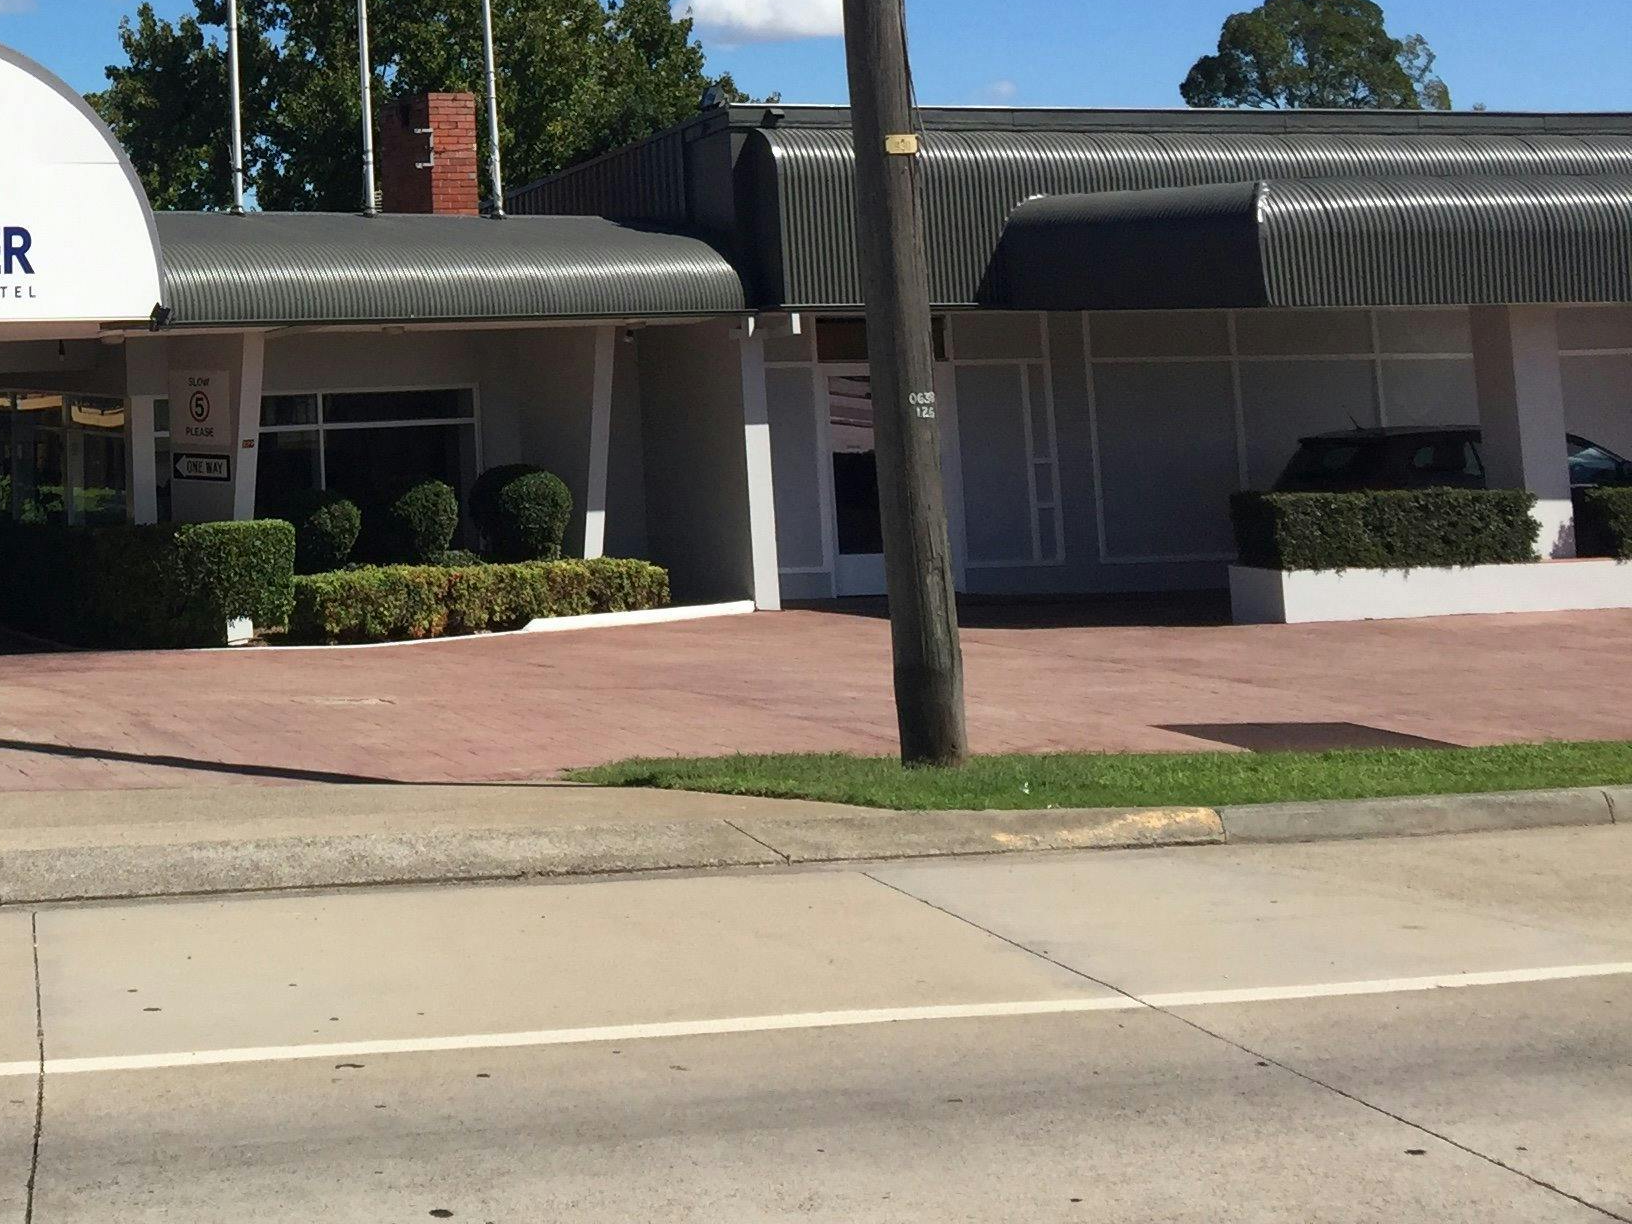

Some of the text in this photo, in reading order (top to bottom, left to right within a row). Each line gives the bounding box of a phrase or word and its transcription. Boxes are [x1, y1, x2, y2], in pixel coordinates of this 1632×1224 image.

[188, 377, 210, 386] SLOW
[194, 397, 205, 417] 5
[185, 427, 214, 437] PLEASE
[186, 459, 223, 474] ONE WAY
